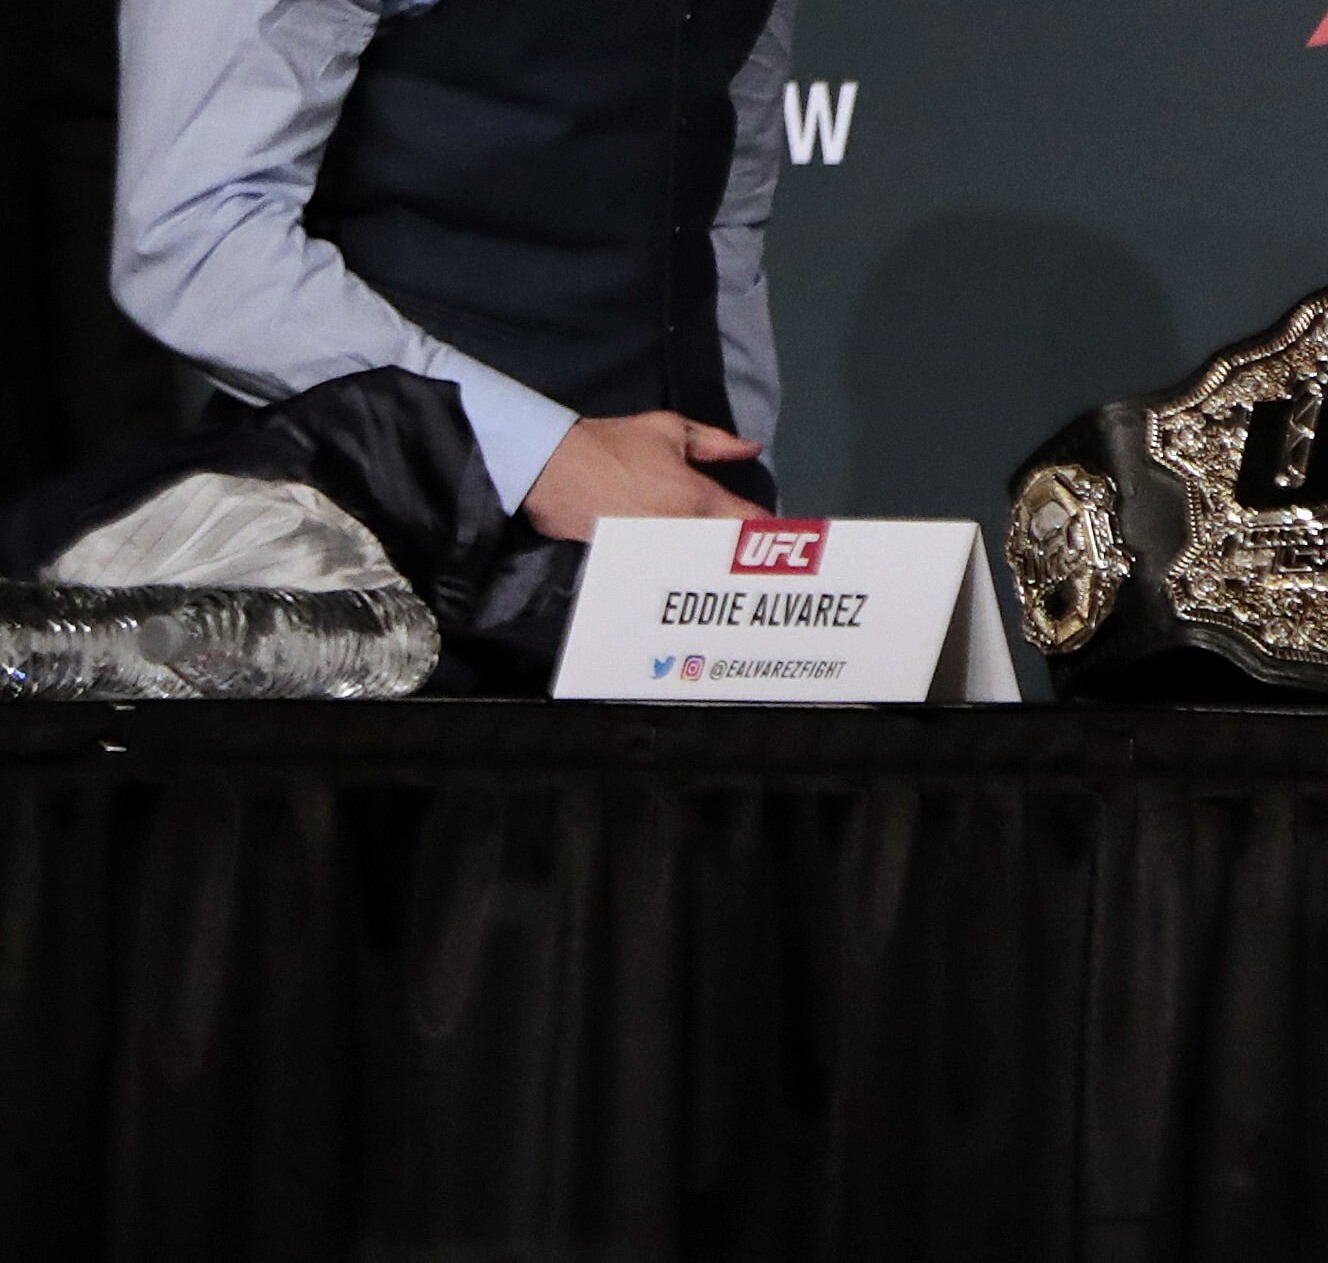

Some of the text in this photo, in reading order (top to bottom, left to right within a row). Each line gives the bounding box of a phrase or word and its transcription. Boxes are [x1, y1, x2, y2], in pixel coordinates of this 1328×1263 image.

[738, 532, 820, 568] UFC
[661, 591, 869, 628] EDDIE ALVAREZ
[709, 659, 848, 681] @EALVAREZFIGHT
